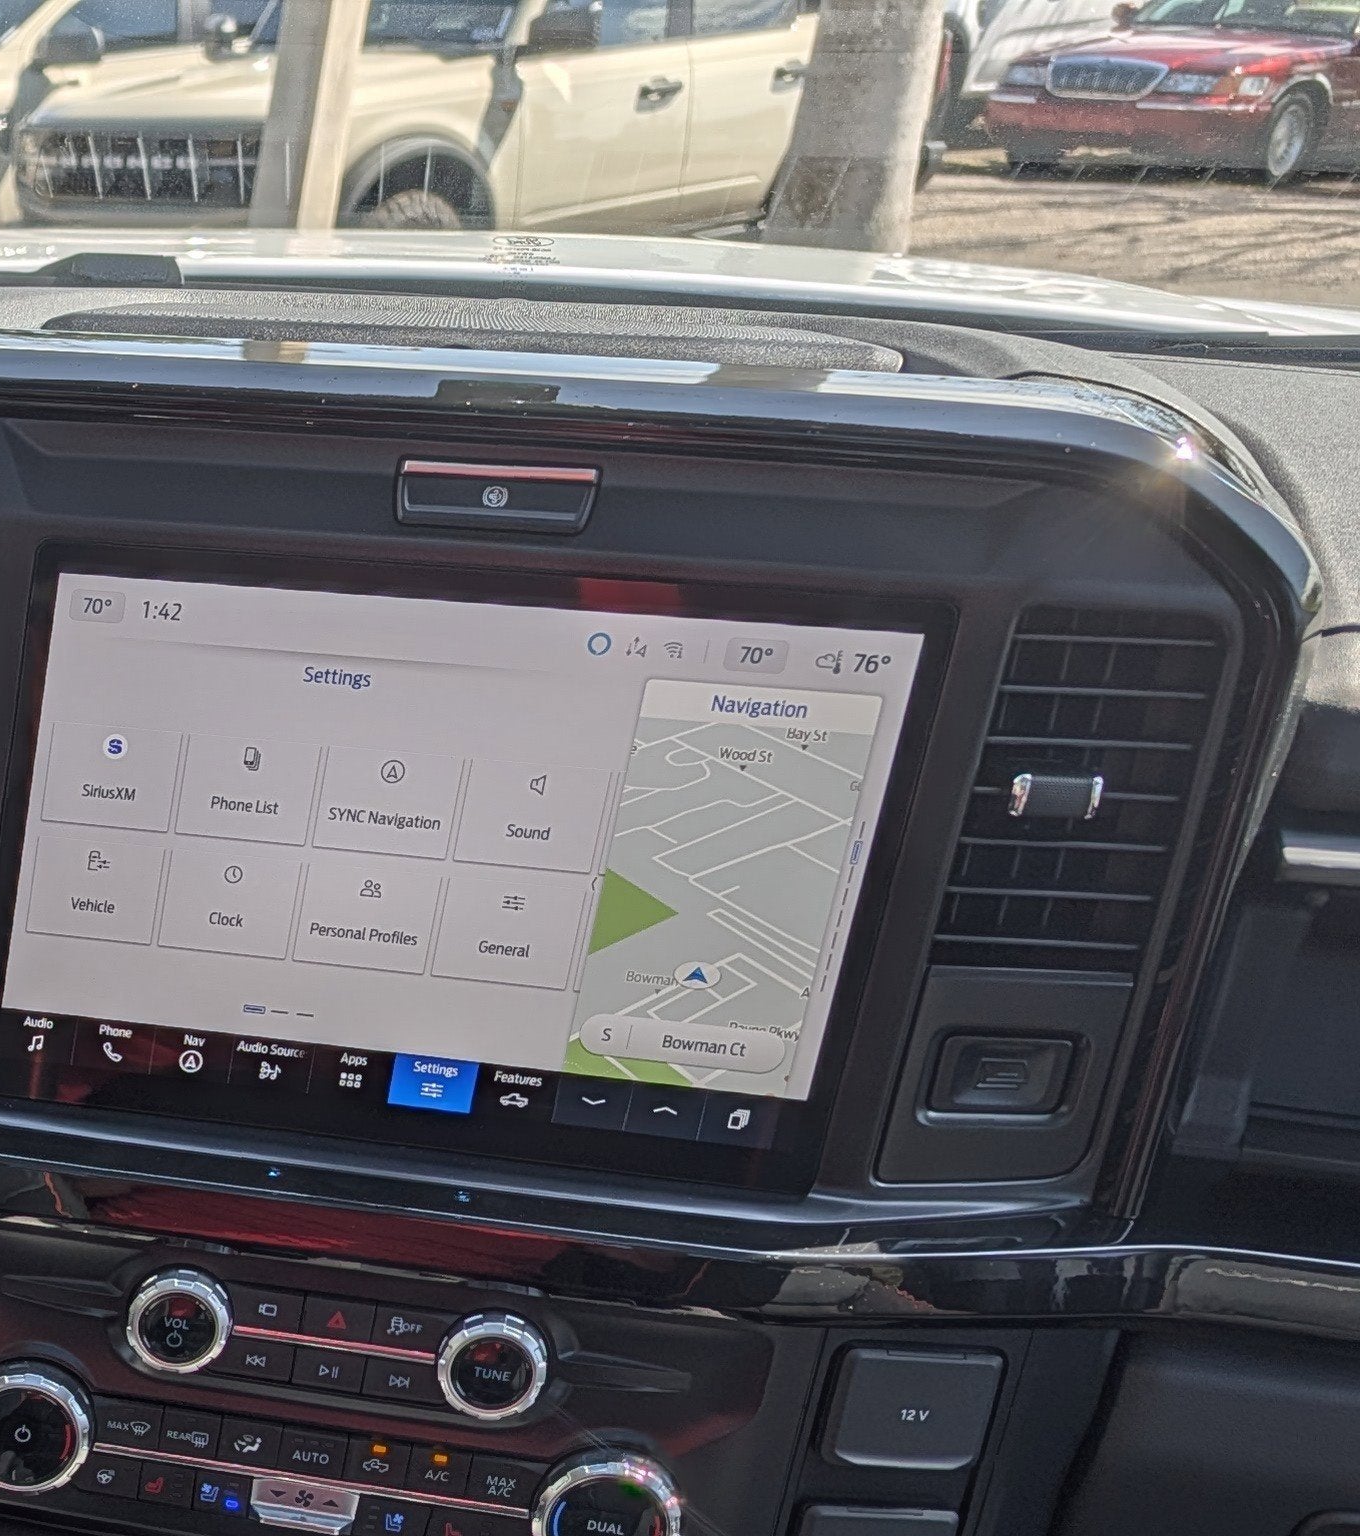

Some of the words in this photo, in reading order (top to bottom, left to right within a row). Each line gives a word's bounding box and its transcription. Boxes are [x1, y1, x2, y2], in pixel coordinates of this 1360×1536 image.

[82, 597, 113, 616] 70°
[142, 600, 182, 622] 1:42
[739, 645, 774, 666] 70°
[853, 653, 892, 674] 76°
[303, 665, 371, 689] Settings
[710, 694, 809, 720] Navigation
[786, 728, 812, 742] Bay
[813, 729, 828, 742] St
[719, 747, 757, 762] Wood
[758, 750, 773, 763] St
[82, 783, 137, 802] SiriusXM
[211, 795, 253, 814] Phone
[256, 799, 279, 816] List
[328, 807, 365, 824] SYNC
[368, 810, 442, 832] Navigation
[505, 823, 551, 842] Sound
[71, 896, 115, 915] Vehicle
[209, 911, 244, 928] Clock
[310, 922, 366, 942] Personal
[368, 929, 418, 947] Profiles
[478, 940, 530, 959] General
[23, 1015, 54, 1030] Audio
[99, 1023, 132, 1039] Phone
[183, 1033, 205, 1048] Nav
[601, 1027, 612, 1042] S
[237, 1040, 268, 1054] Audio
[662, 1035, 727, 1054] Bowman
[730, 1042, 747, 1057] Ct
[340, 1052, 368, 1067] Apps
[413, 1060, 459, 1078] Settings
[494, 1070, 543, 1088] Features
[163, 1315, 190, 1332] VOL
[403, 1323, 423, 1335] OFF
[472, 1366, 511, 1384] TUNE
[900, 1408, 915, 1421] 12
[918, 1409, 930, 1422] V
[106, 1420, 130, 1433] MAX
[166, 1430, 192, 1443] REAR
[292, 1449, 330, 1465] AUTO
[424, 1468, 450, 1483] A/C
[486, 1475, 517, 1490] MAX
[486, 1485, 513, 1499] A/C
[586, 1519, 625, 1536] DUAL
